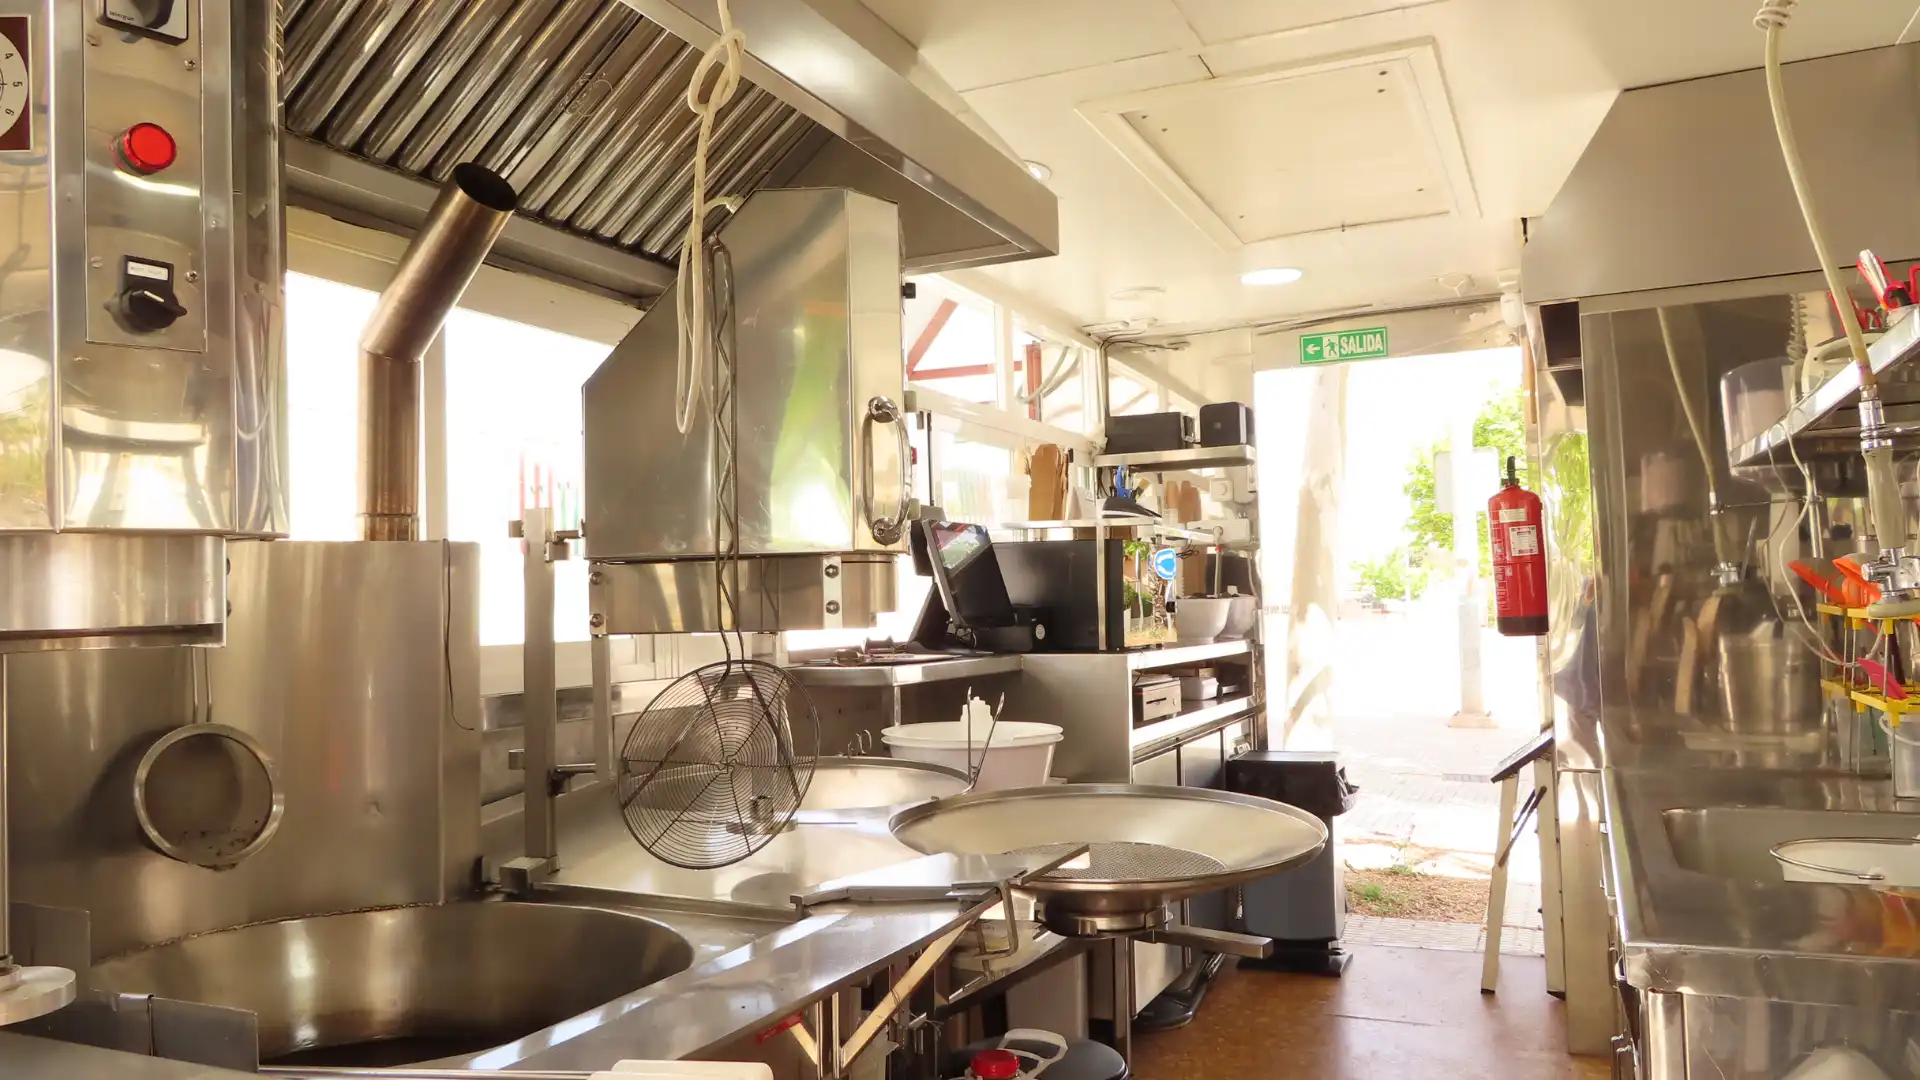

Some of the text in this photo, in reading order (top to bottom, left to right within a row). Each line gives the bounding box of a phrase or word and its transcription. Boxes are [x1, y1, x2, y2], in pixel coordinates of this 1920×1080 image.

[4, 52, 14, 60] 4
[4, 108, 15, 116] 6
[1340, 333, 1384, 355] SALIDA
